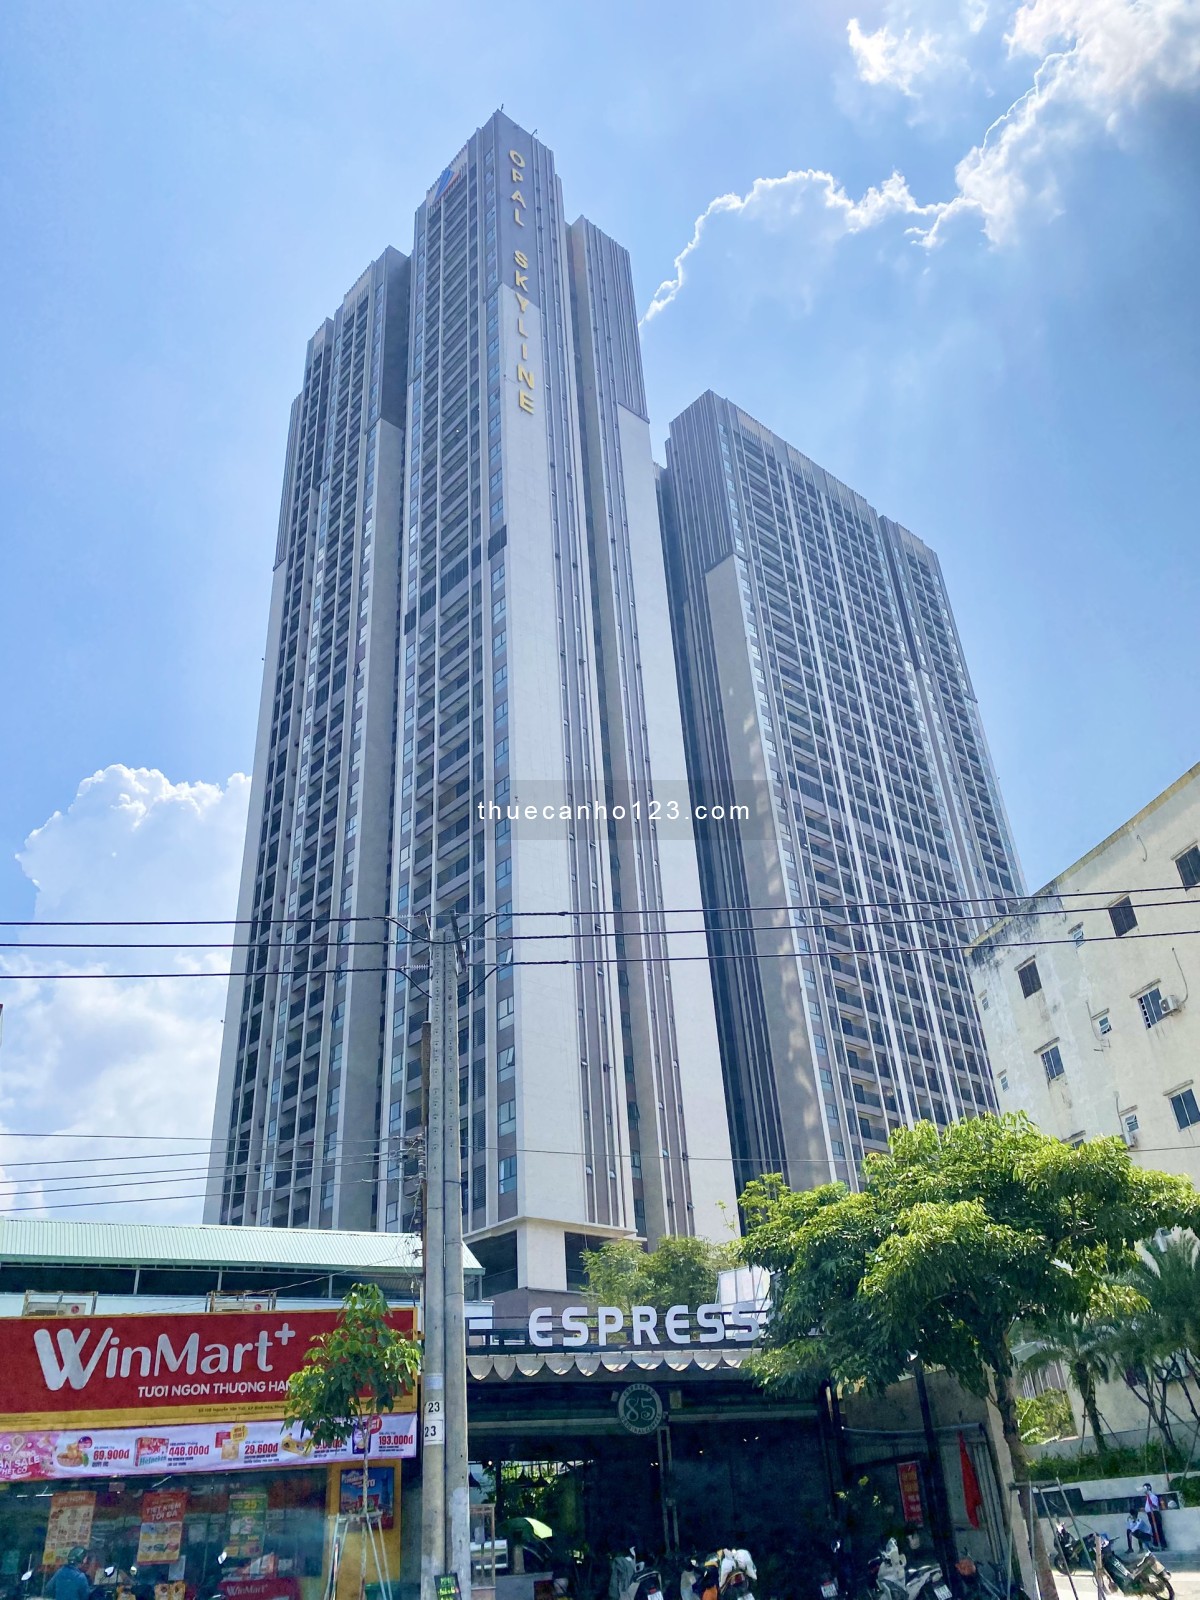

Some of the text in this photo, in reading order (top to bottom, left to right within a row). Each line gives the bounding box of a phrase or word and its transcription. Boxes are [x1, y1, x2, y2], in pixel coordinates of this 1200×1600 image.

[508, 149, 535, 416] OPAL SKYLINE
[528, 1302, 760, 1347] ESPRESS
[171, 1383, 210, 1397] NGON
[427, 1401, 441, 1413] 23
[625, 1397, 656, 1422] 85
[424, 1425, 437, 1438] 23
[14, 1454, 40, 1468] SALE
